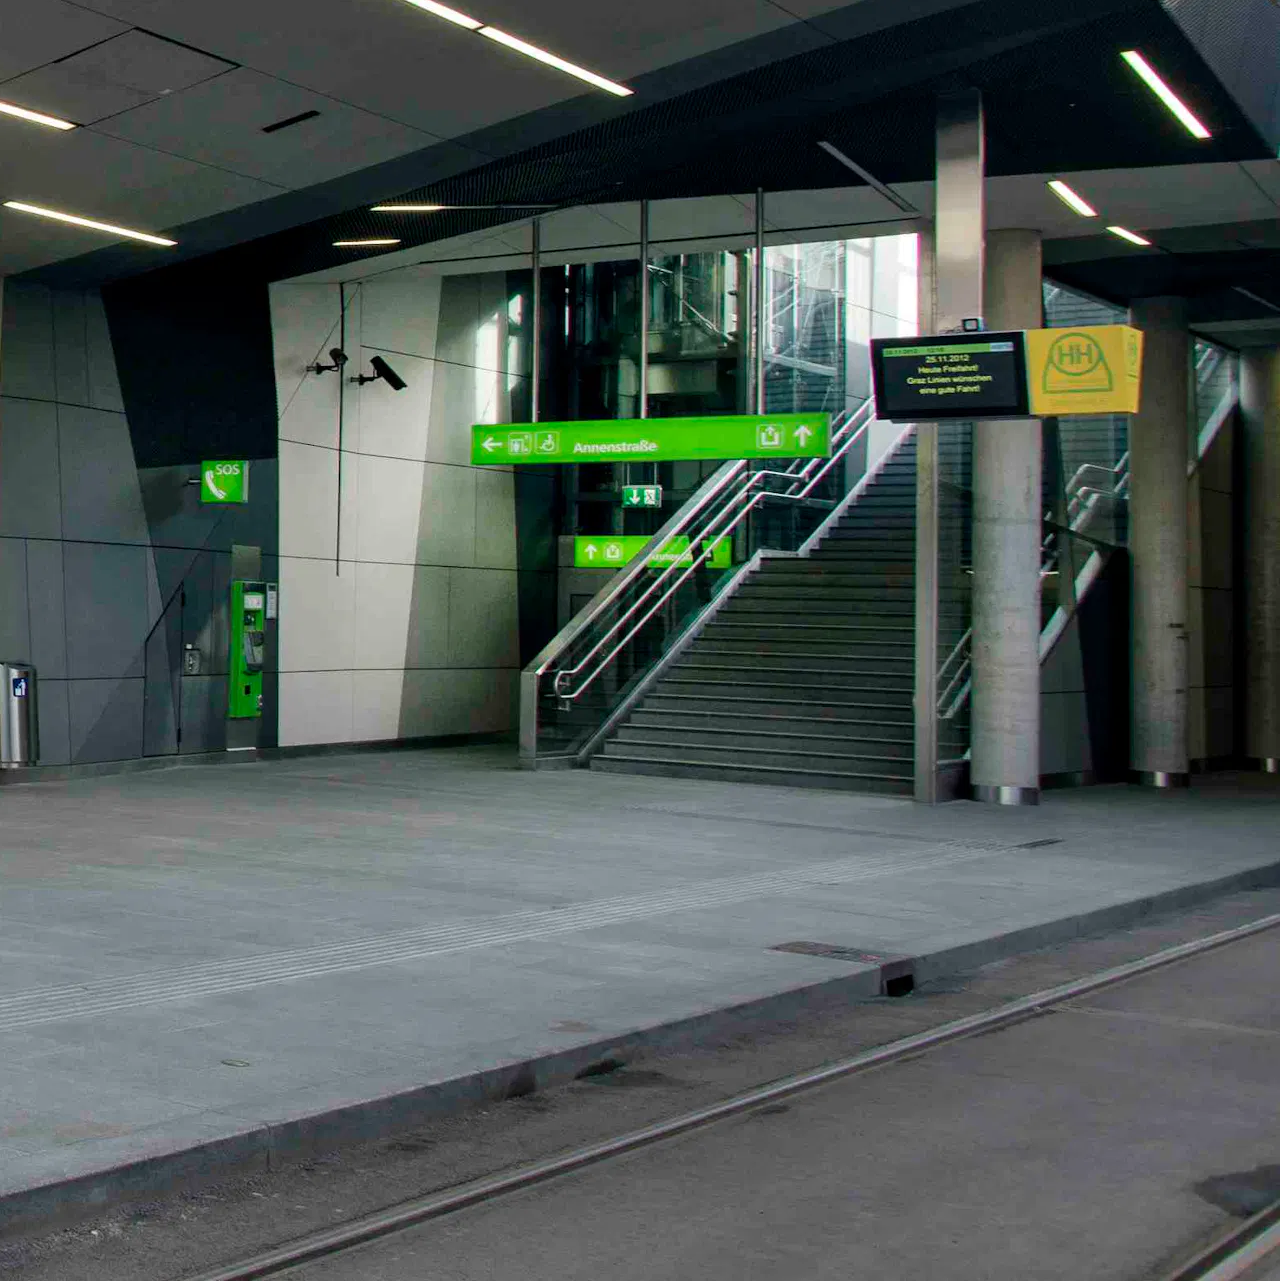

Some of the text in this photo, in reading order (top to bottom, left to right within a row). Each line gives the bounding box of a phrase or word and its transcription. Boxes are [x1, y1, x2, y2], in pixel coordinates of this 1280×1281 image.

[918, 364, 979, 374] Heute Freifahrt!
[906, 374, 993, 385] Graz Linien wünschen
[919, 385, 981, 395] eine gute Fahrt!
[572, 439, 658, 455] Annenstraße
[215, 463, 240, 475] SOS
